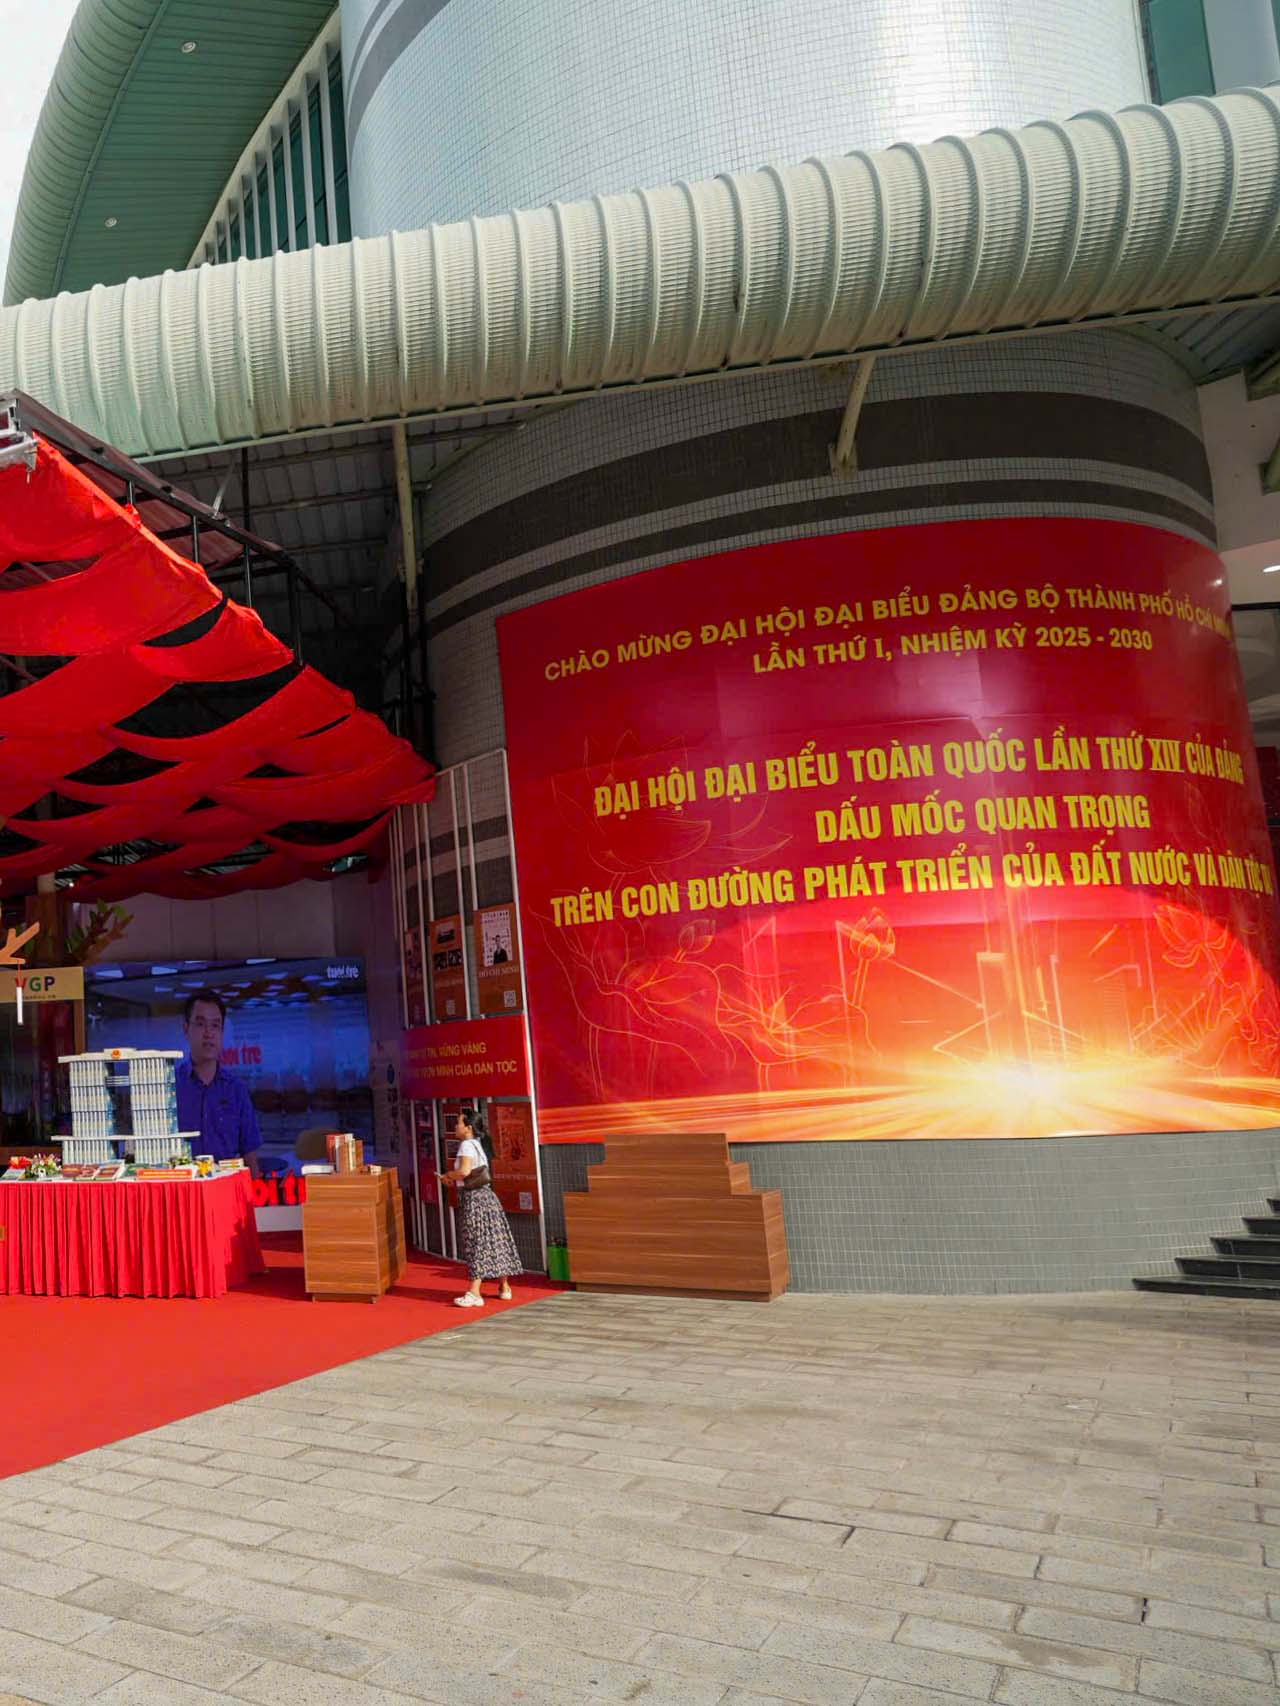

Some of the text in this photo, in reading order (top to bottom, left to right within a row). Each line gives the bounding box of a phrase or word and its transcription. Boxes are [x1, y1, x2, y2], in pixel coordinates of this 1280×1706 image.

[545, 649, 609, 680] CHÀO
[617, 630, 692, 662] MỪNG
[700, 619, 746, 646] ĐẠI
[756, 607, 805, 636] HỘI
[814, 602, 863, 629] ĐẠI
[872, 586, 928, 620] BIỂU
[939, 584, 1018, 613] ĐẢNG
[1025, 584, 1060, 613] BỘ
[1066, 588, 1135, 611] THÀNH
[1139, 589, 1173, 616] PHỐ
[753, 642, 805, 673] LẦN
[813, 635, 867, 665] THỨ
[875, 639, 892, 661] I,
[901, 625, 987, 657] NHIỆM
[996, 621, 1027, 648] KỲ
[1035, 627, 1092, 647] 2025
[1109, 628, 1152, 650] 2030
[594, 784, 640, 820] ĐẠI
[648, 766, 697, 811] HỘI
[705, 762, 756, 802] ĐẠI
[766, 740, 839, 791] BIỂU
[847, 738, 933, 783] TOÀN
[943, 727, 1026, 780] QUỐC
[1034, 725, 1089, 772] LẦN
[1095, 730, 1144, 770] THỨ
[1146, 738, 1185, 773] XIV
[1185, 733, 1216, 777] CỦA
[815, 789, 1151, 844] DẤU MỐC QUAN TRỌNG
[551, 887, 614, 928] TRÊN
[621, 882, 679, 918] CON
[687, 866, 794, 911] ĐƯỜNG
[803, 856, 887, 901] PHÁT
[896, 842, 993, 895] TRIỂN
[1002, 841, 1065, 888] CỦA
[1070, 839, 1122, 887] ĐẤT
[1129, 844, 1191, 886] NƯỚC
[1193, 847, 1219, 886] VÀ
[1218, 850, 1246, 889] DÂN
[15, 976, 56, 991] VGP
